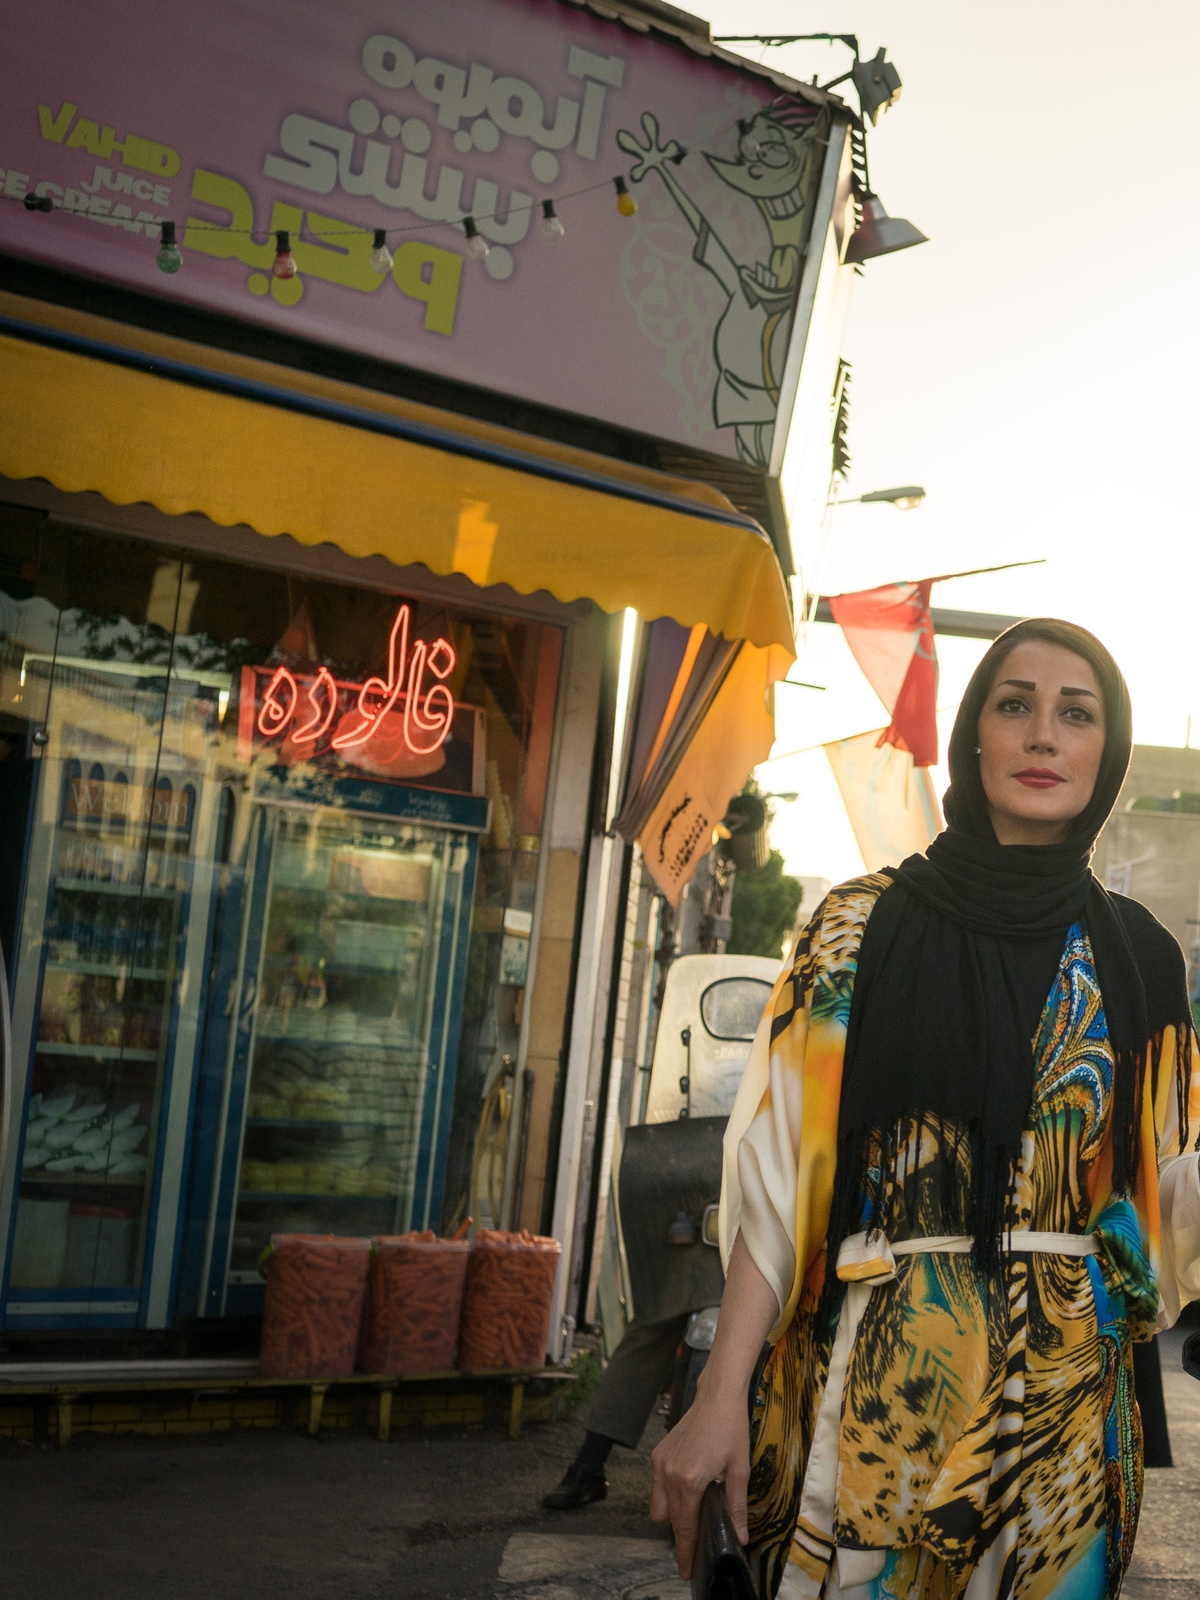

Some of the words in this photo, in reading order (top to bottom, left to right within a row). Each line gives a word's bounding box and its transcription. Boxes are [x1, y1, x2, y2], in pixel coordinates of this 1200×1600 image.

[37, 102, 181, 178] VAHID
[362, 34, 625, 183] آبمیوه
[35, 181, 172, 240] CREAM
[80, 165, 172, 206] JUICE
[184, 168, 463, 336] وحید
[263, 98, 532, 280] بستنی
[257, 604, 456, 754] فالوده
